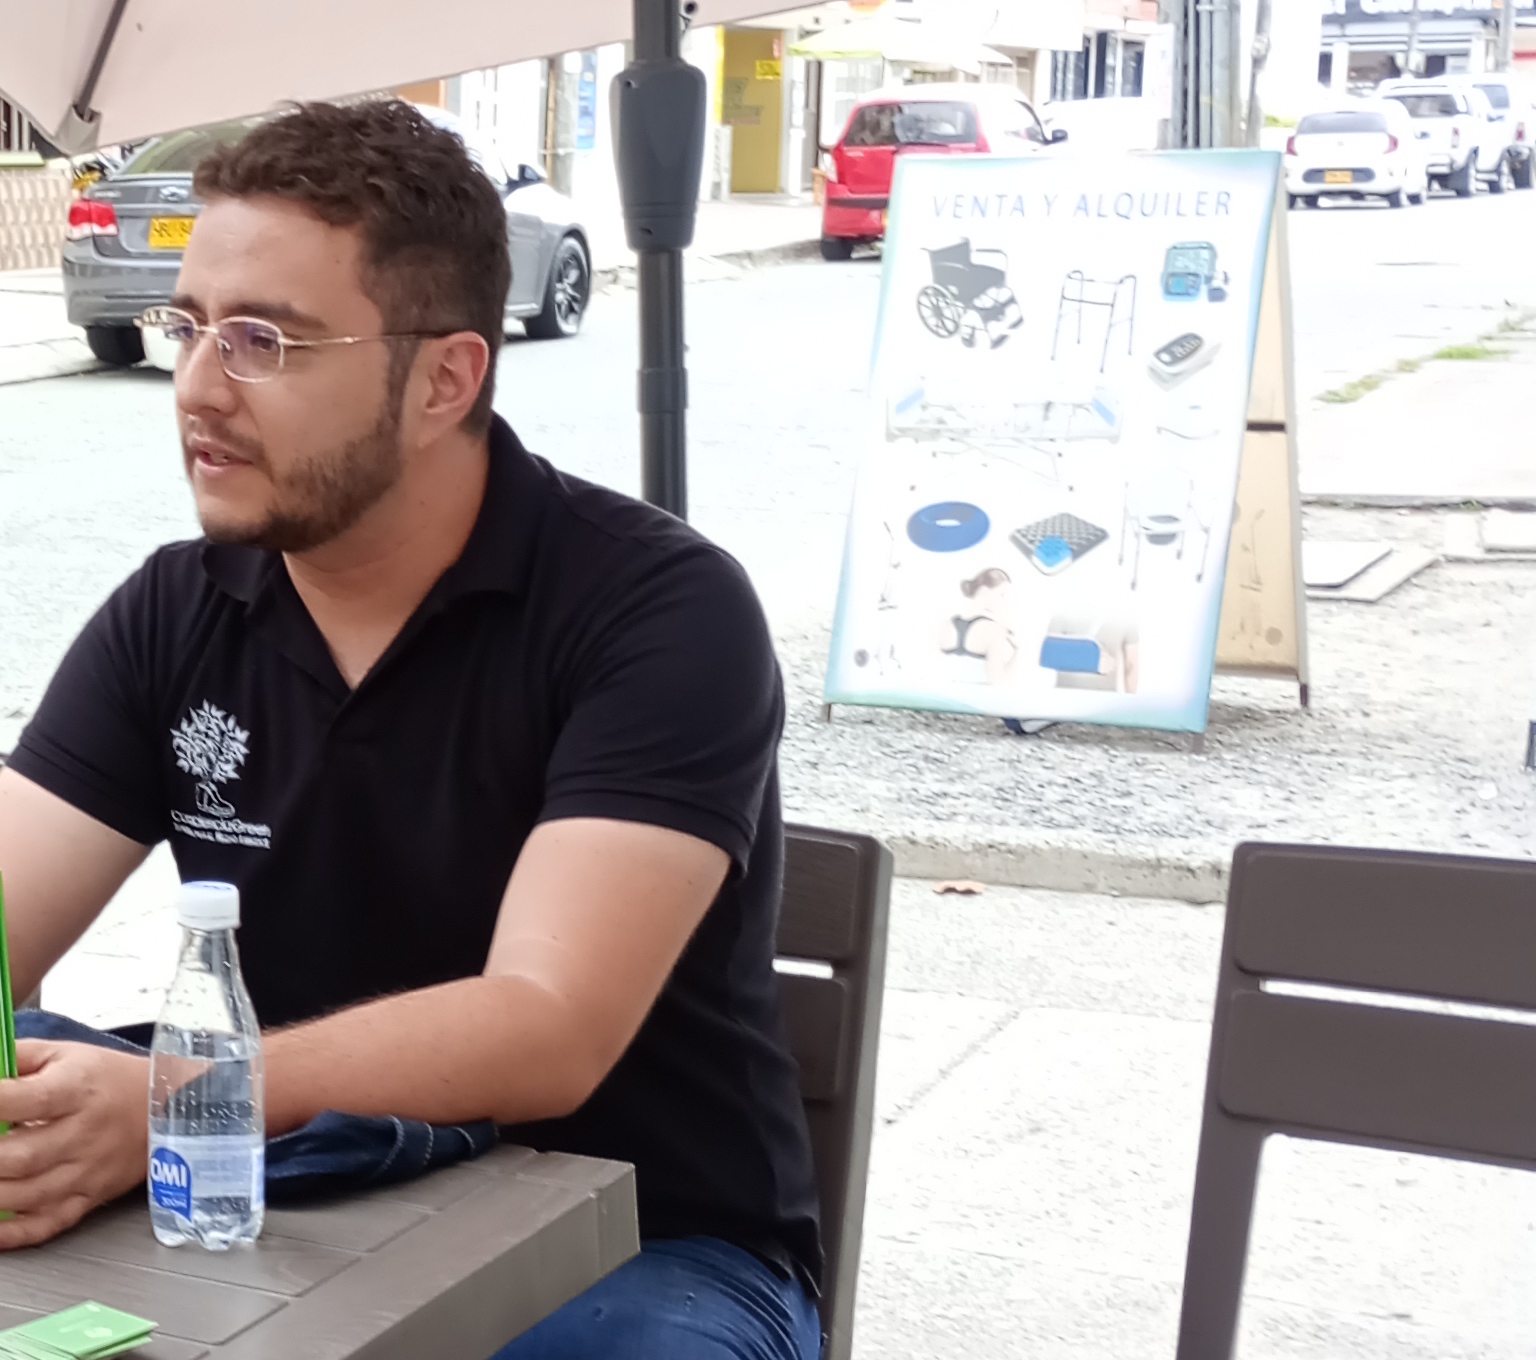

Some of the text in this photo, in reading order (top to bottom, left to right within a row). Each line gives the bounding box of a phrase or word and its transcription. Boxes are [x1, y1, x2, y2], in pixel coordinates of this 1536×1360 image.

[933, 191, 1232, 221] VENTA Y ALQUILER
